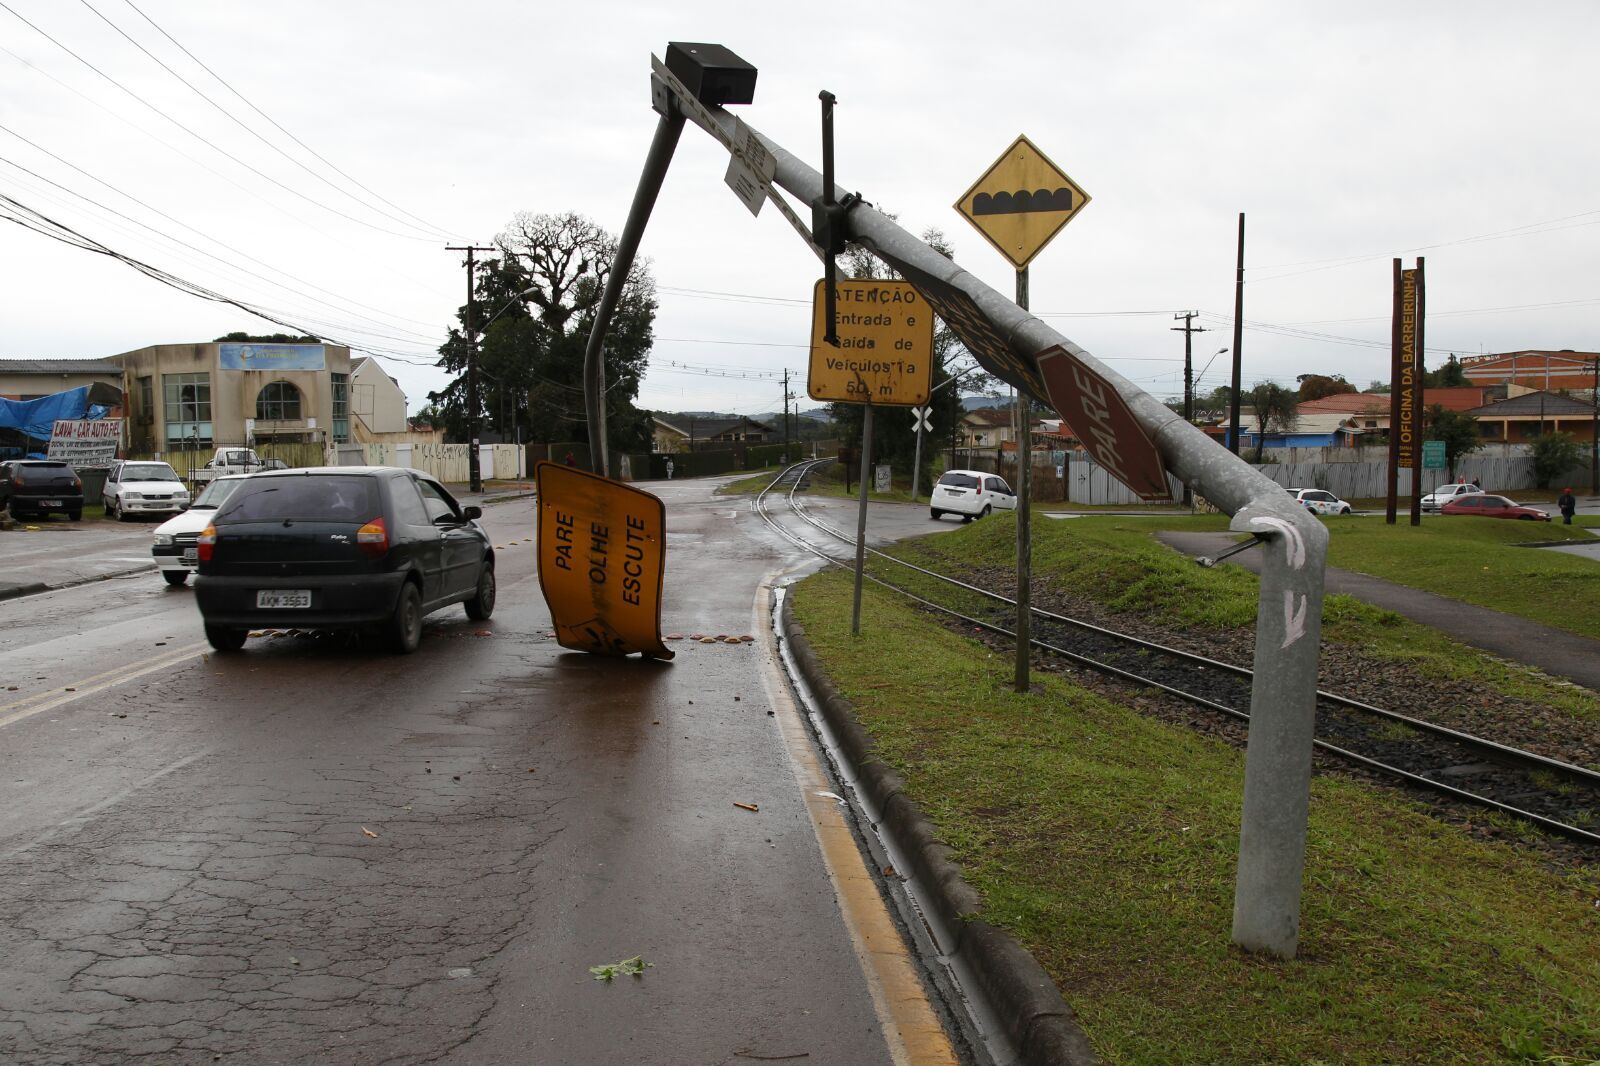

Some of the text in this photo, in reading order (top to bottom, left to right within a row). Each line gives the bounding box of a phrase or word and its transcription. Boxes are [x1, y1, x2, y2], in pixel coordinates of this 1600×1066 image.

[907, 316, 916, 326] e
[1402, 270, 1415, 364] BARREIRINHA
[895, 338, 913, 350] de
[907, 363, 916, 374] a
[1402, 366, 1413, 385] DA
[879, 386, 893, 395] m
[54, 421, 73, 437] LAVA
[77, 422, 90, 438] CAR
[90, 422, 109, 437] AUTO
[1072, 365, 1129, 480] PARE
[1400, 388, 1413, 443] OFICINA
[556, 511, 574, 571] PARE
[589, 522, 609, 585] OLHE
[623, 514, 645, 606] ESCUTE
